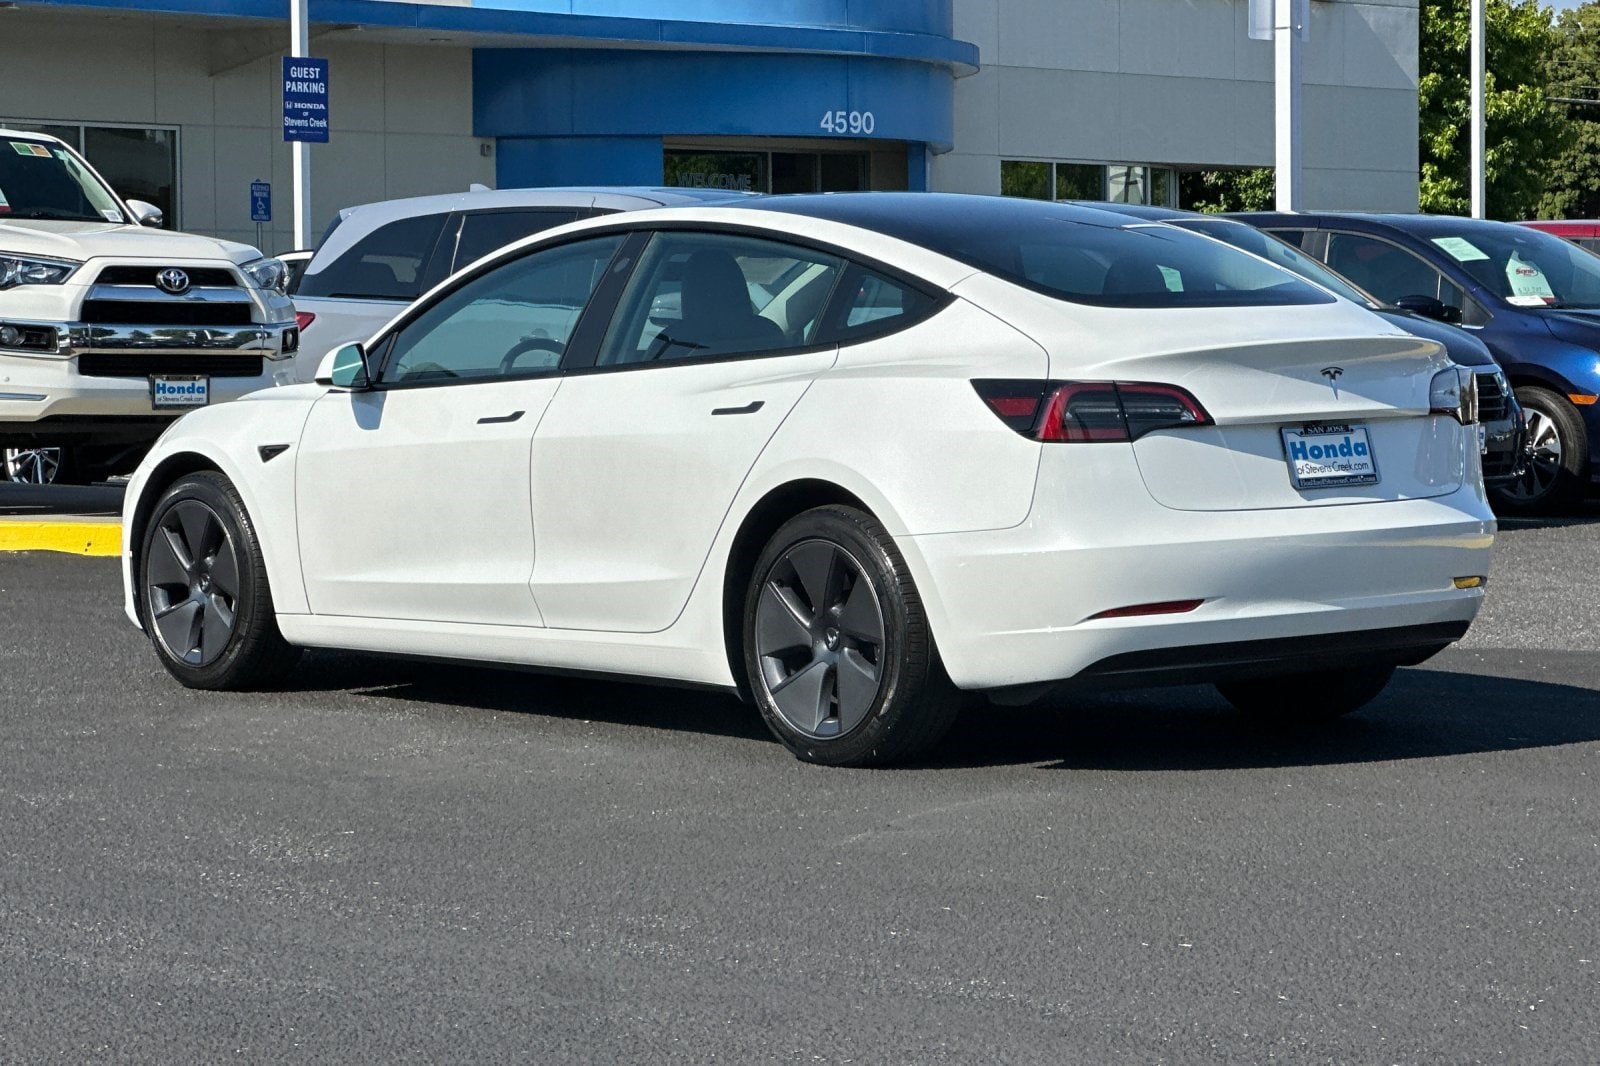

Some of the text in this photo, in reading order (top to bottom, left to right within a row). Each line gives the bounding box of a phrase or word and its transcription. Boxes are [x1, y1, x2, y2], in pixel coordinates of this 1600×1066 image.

[290, 66, 321, 79] GUEST
[285, 81, 325, 94] PARKING
[294, 102, 326, 110] HONDA
[284, 116, 327, 128] Stevens Creek
[820, 110, 875, 134] 4590
[675, 171, 752, 192] WELCOME
[156, 382, 205, 394] Honda
[1307, 425, 1347, 435] SAN JOSE
[1289, 436, 1368, 461] Honda
[1297, 465, 1306, 475] of
